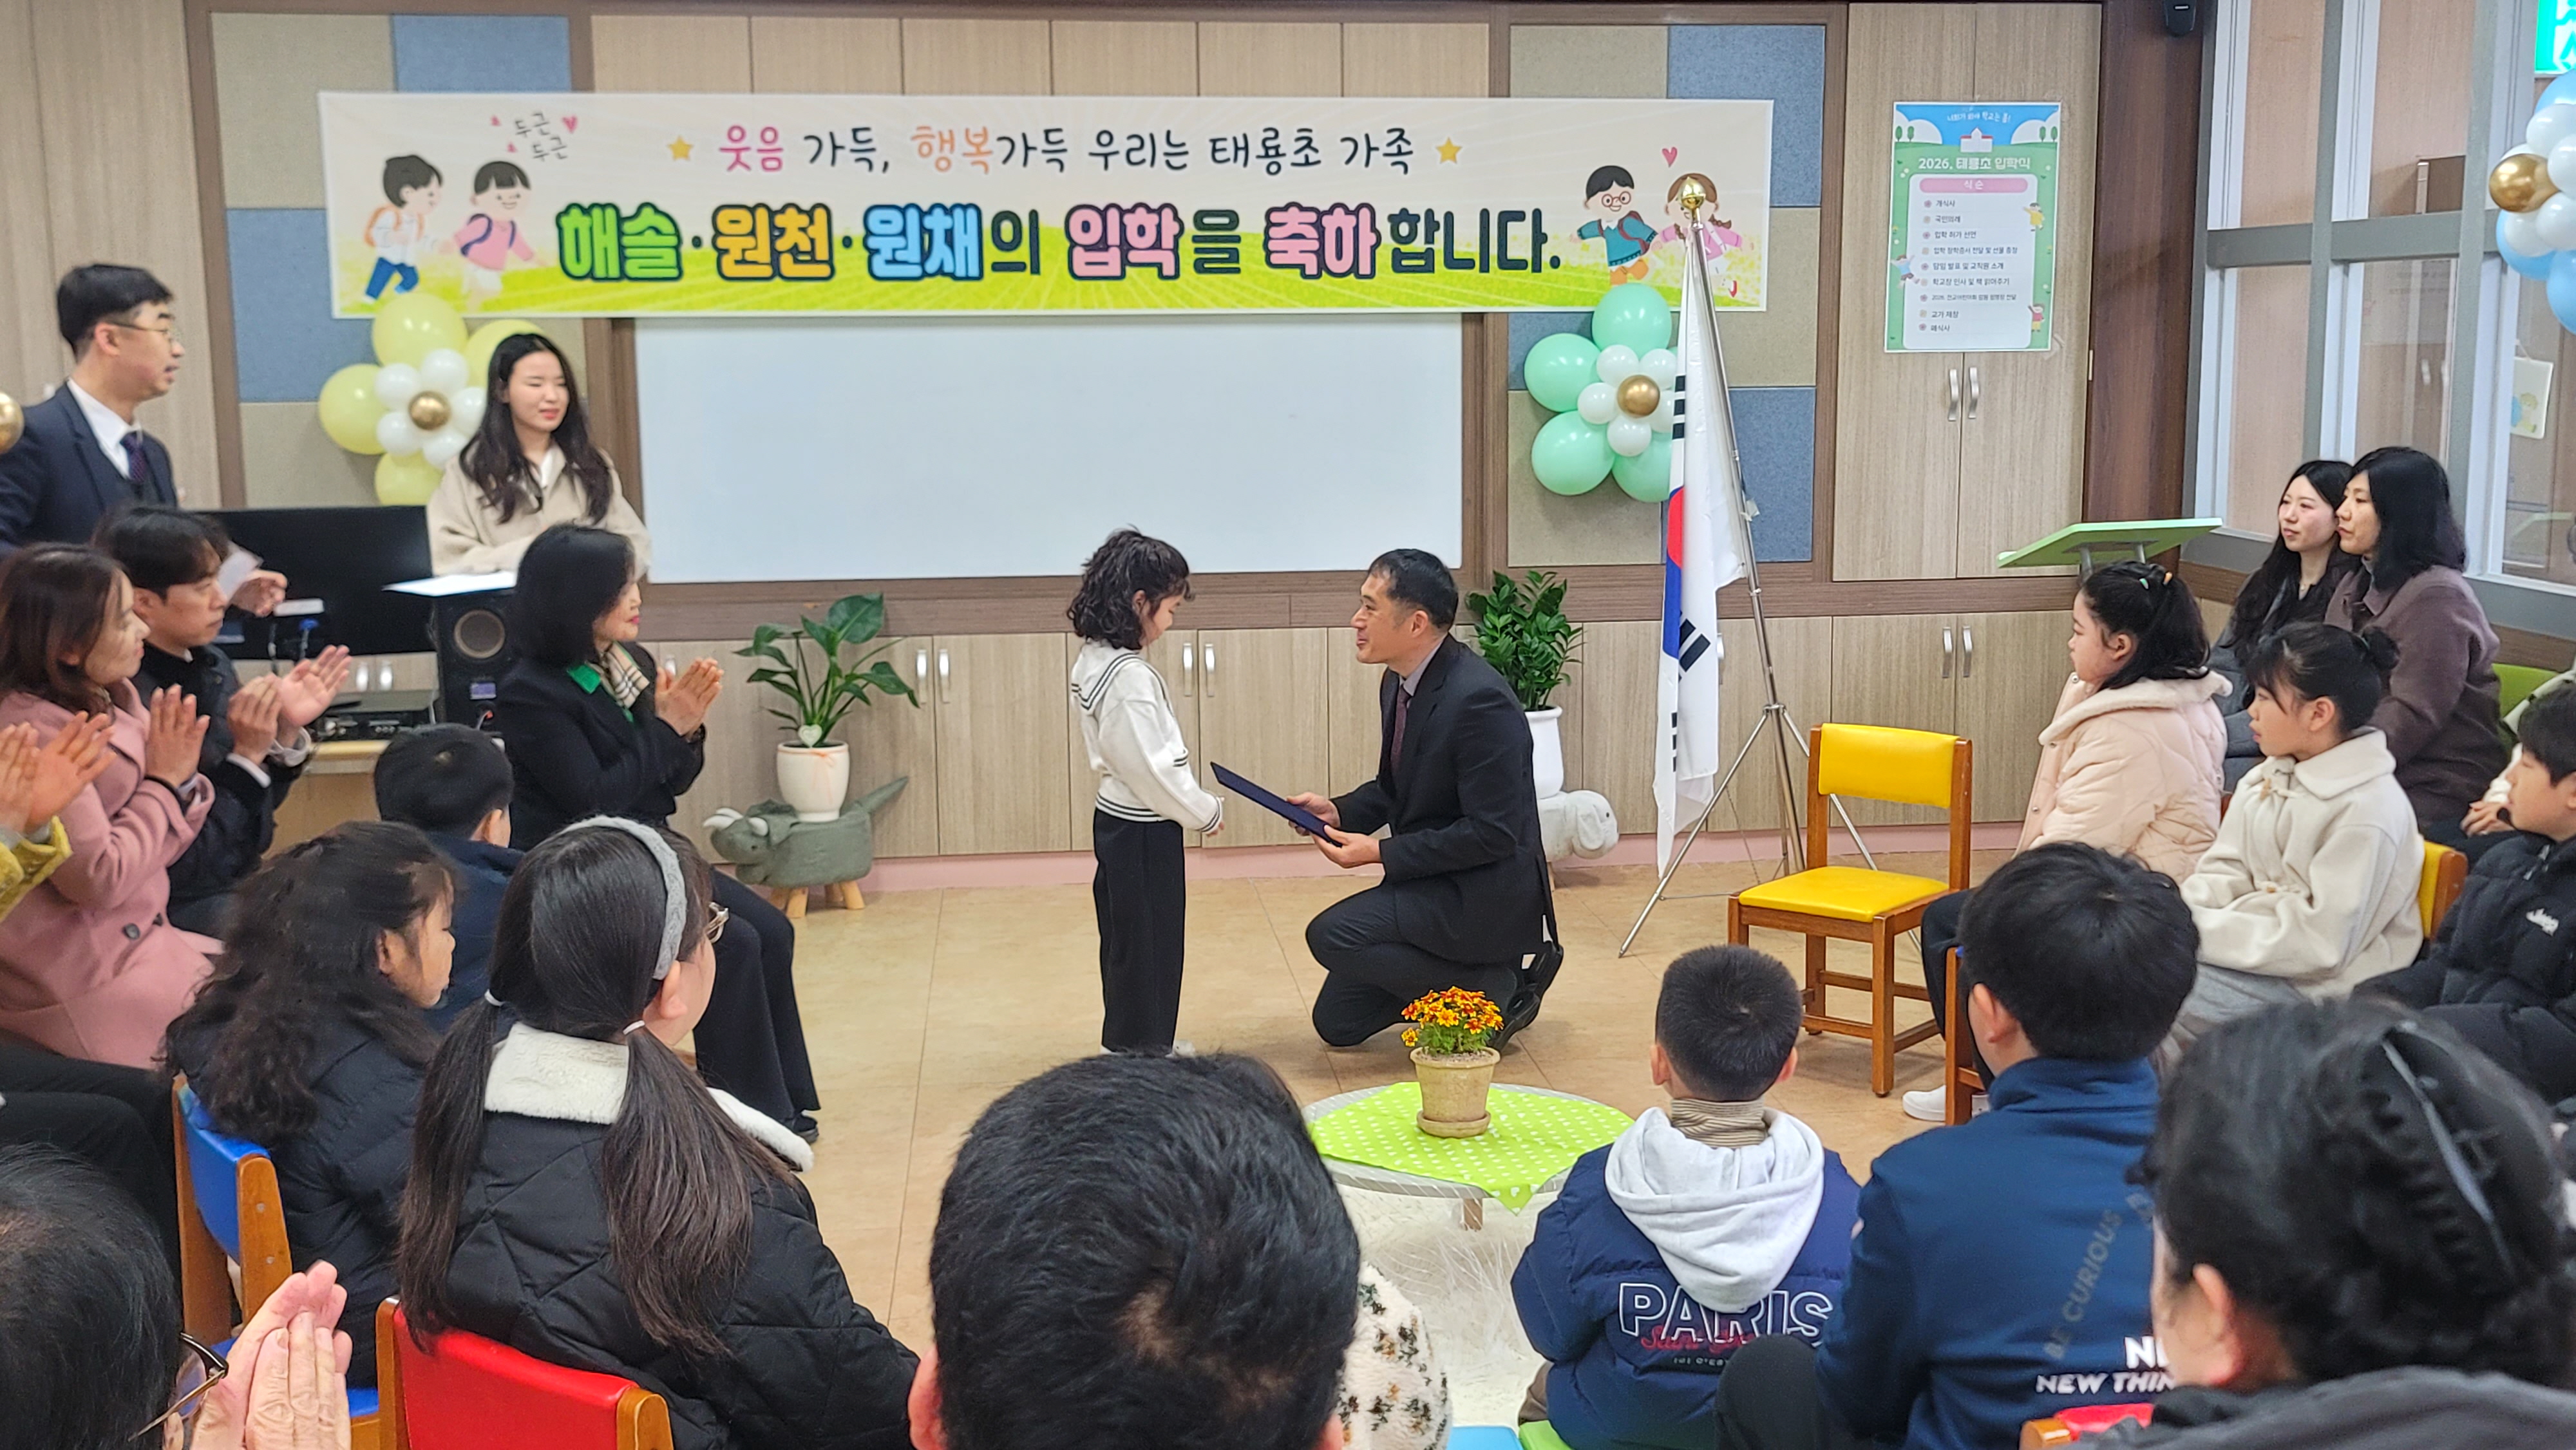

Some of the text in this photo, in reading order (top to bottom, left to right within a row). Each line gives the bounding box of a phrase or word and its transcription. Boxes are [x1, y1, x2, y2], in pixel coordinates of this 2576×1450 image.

[516, 110, 549, 138] 두근
[1982, 111, 2000, 122] 학교는
[533, 136, 567, 162] 두근
[719, 124, 1414, 176] 웃음 가득, 행복가득 우리는 태룡초 가족
[1918, 157, 2031, 170] 2026. 태룡초 입학식
[1064, 202, 1242, 281] 입학을
[1264, 202, 1562, 280] 축하합니다.
[1964, 231, 1976, 239] 선언
[1933, 262, 1946, 270] 담임
[2062, 1209, 2123, 1323] CURIOUS
[1619, 1283, 1833, 1348] PARIS
[2035, 1372, 2109, 1395] NEW
